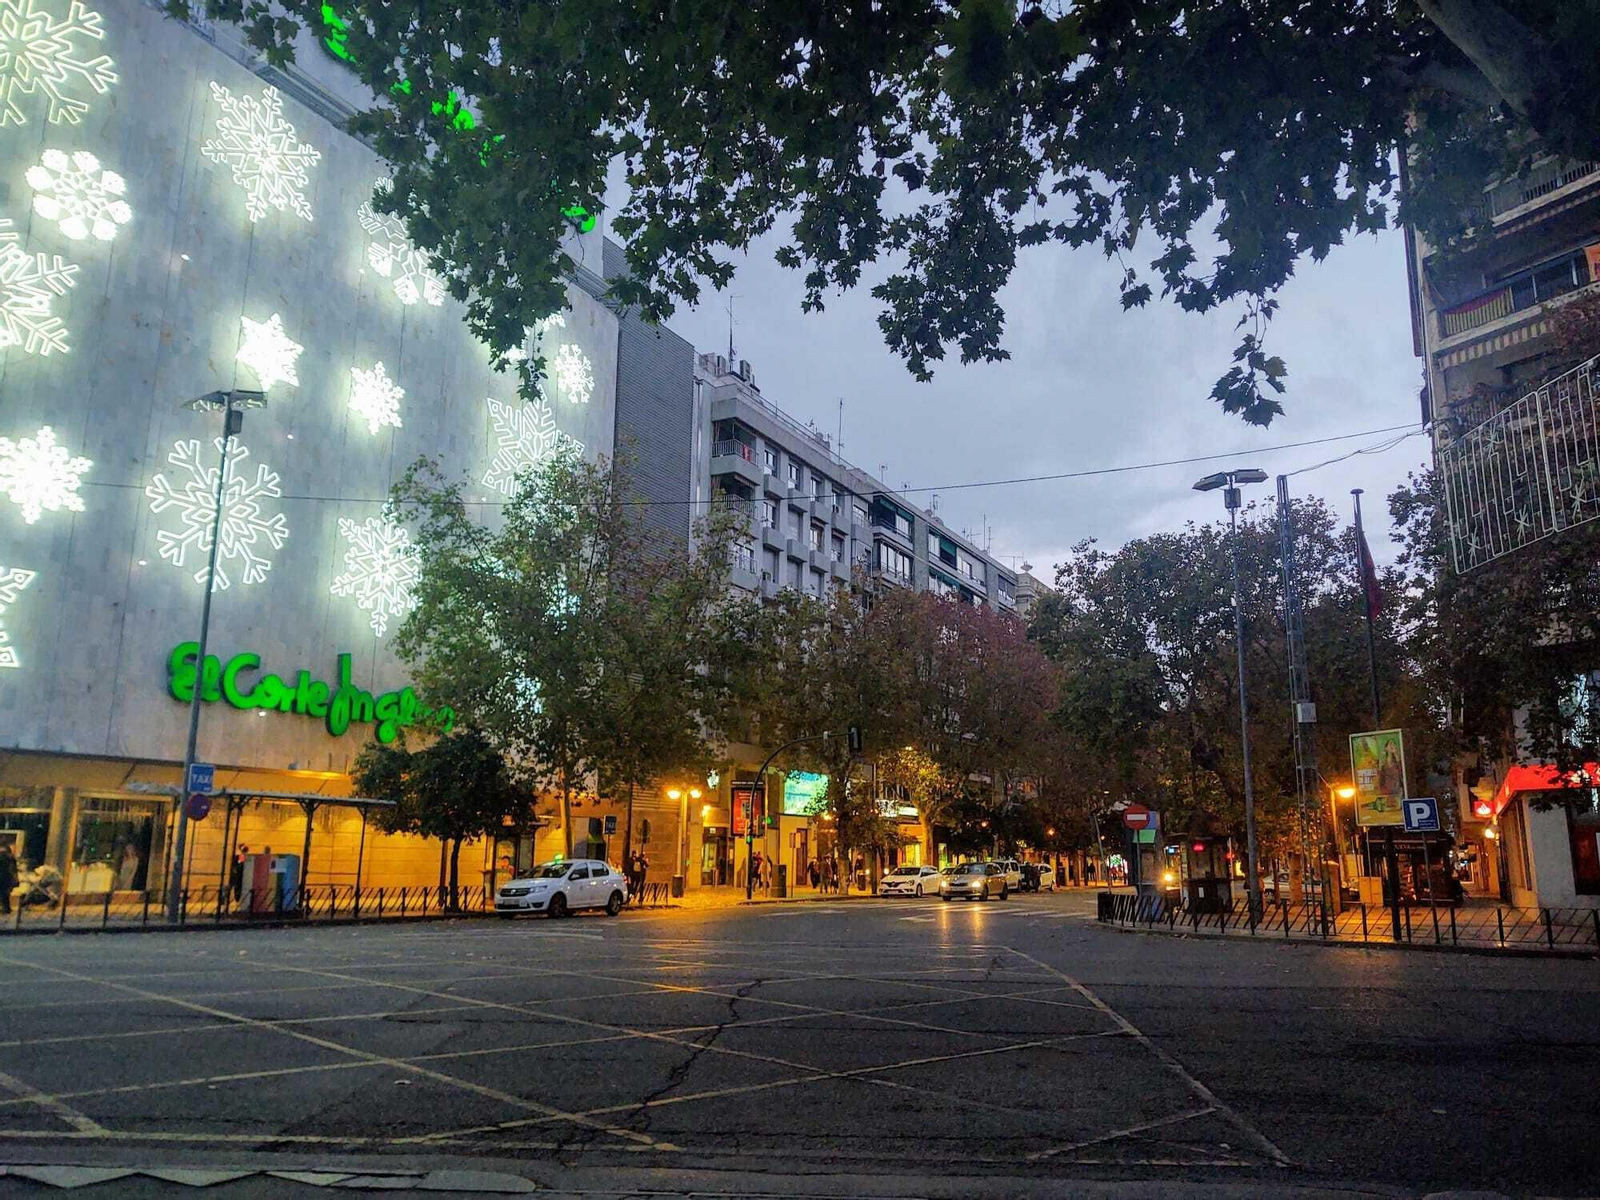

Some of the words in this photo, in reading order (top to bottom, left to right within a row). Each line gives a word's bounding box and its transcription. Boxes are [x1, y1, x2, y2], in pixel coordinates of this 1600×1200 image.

[167, 641, 221, 702] El
[219, 652, 330, 717] Corte
[1408, 802, 1431, 828] P
